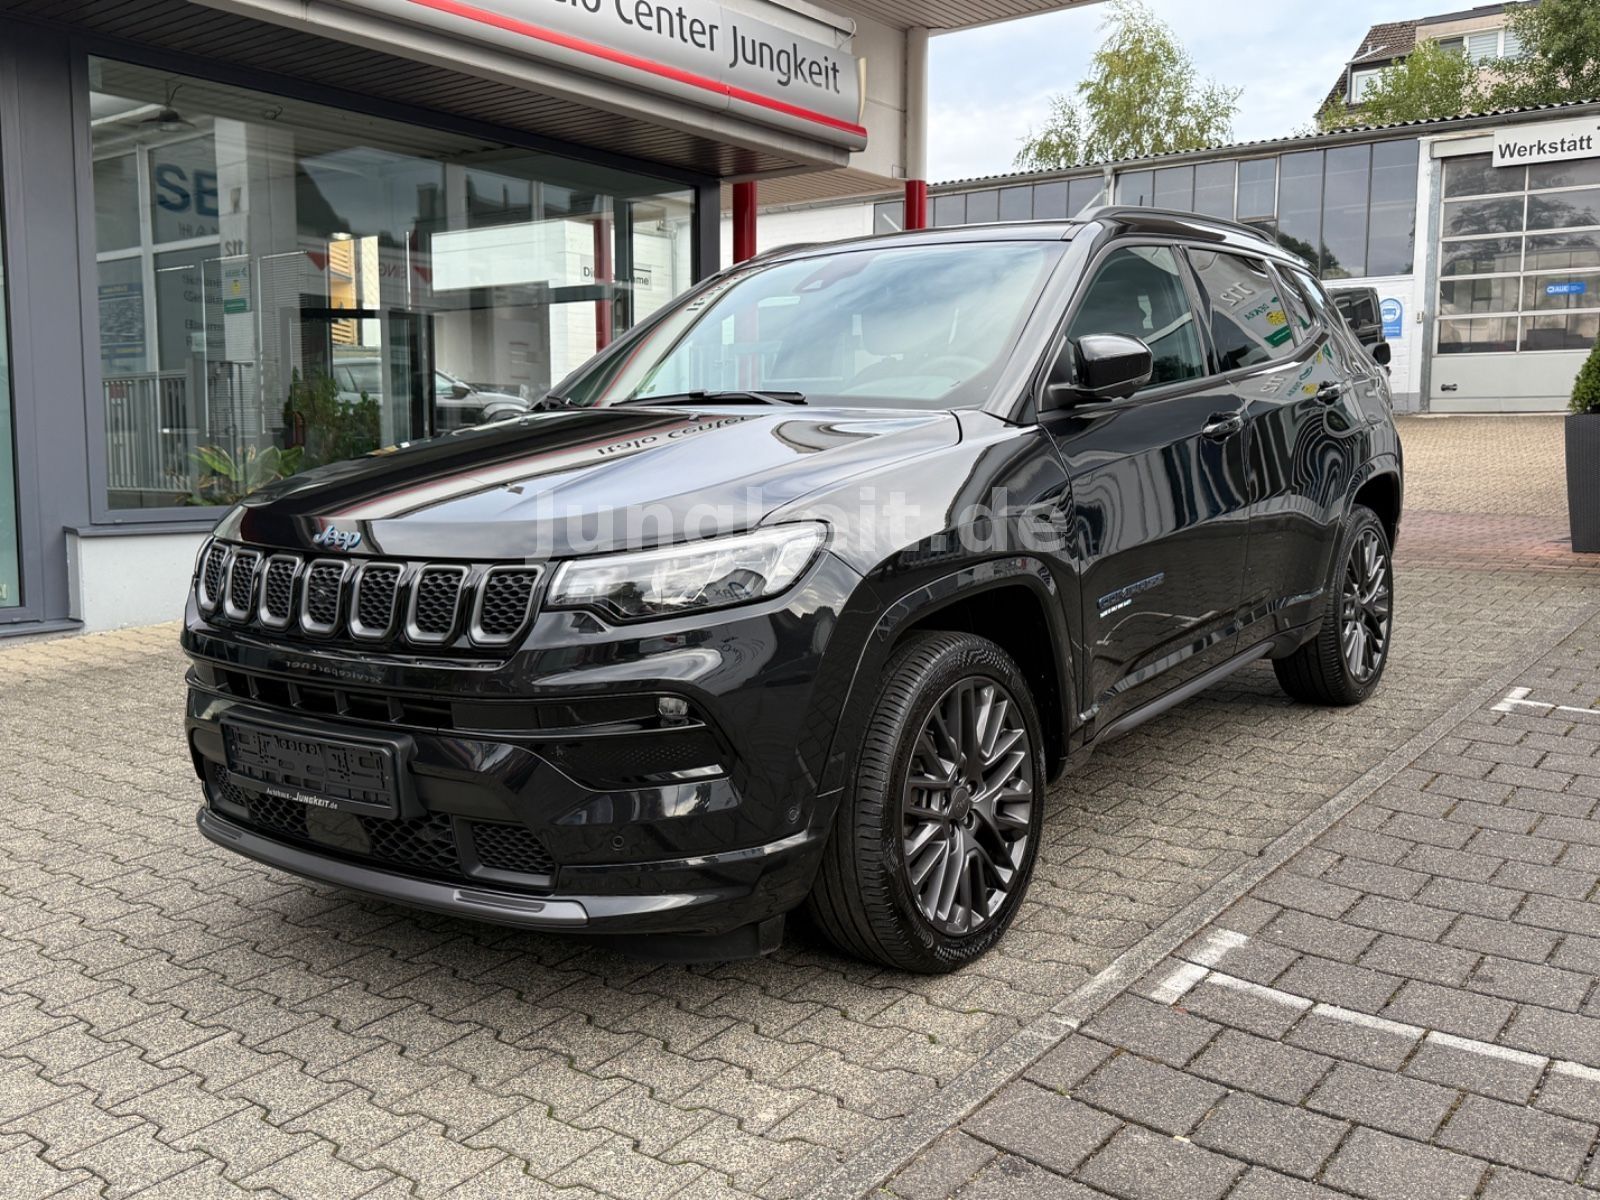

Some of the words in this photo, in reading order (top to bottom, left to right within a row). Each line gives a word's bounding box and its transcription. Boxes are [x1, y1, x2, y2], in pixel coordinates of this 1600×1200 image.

[729, 25, 841, 95] Jungkeit
[1498, 135, 1593, 159] Werkstatt
[313, 524, 362, 551] Jeep
